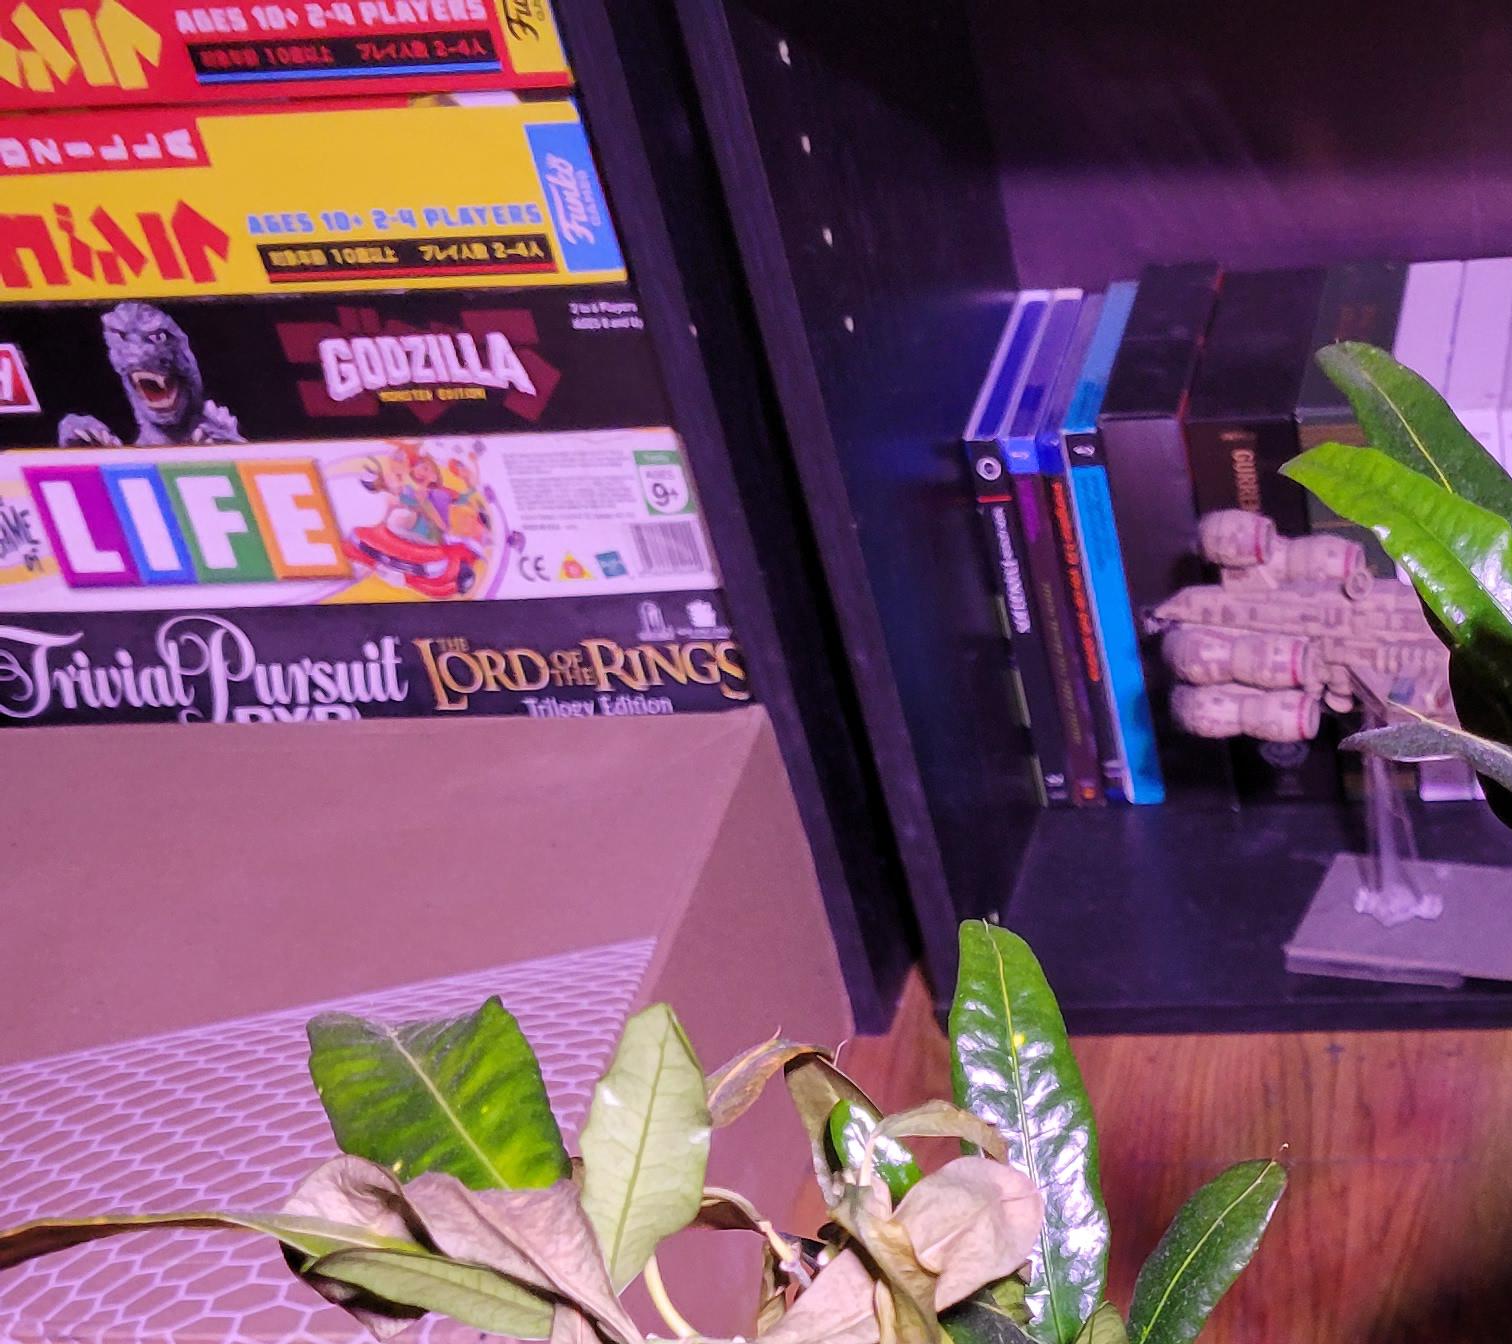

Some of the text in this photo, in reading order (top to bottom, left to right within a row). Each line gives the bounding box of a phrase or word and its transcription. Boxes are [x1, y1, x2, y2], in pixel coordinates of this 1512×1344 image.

[175, 0, 488, 35] AGES 10+ 2-4 PLAYERS
[247, 203, 544, 235] AGES 10+ 2-4 PLAYERS
[545, 152, 595, 245] Funko
[319, 331, 537, 401] GODZILLA
[39, 473, 336, 574] LIFE
[652, 482, 679, 507] 9+
[0, 614, 409, 724] Trivial Pursuit
[412, 638, 750, 710] LORD OF THE RINGS
[522, 693, 674, 718] Trilogy Edition
